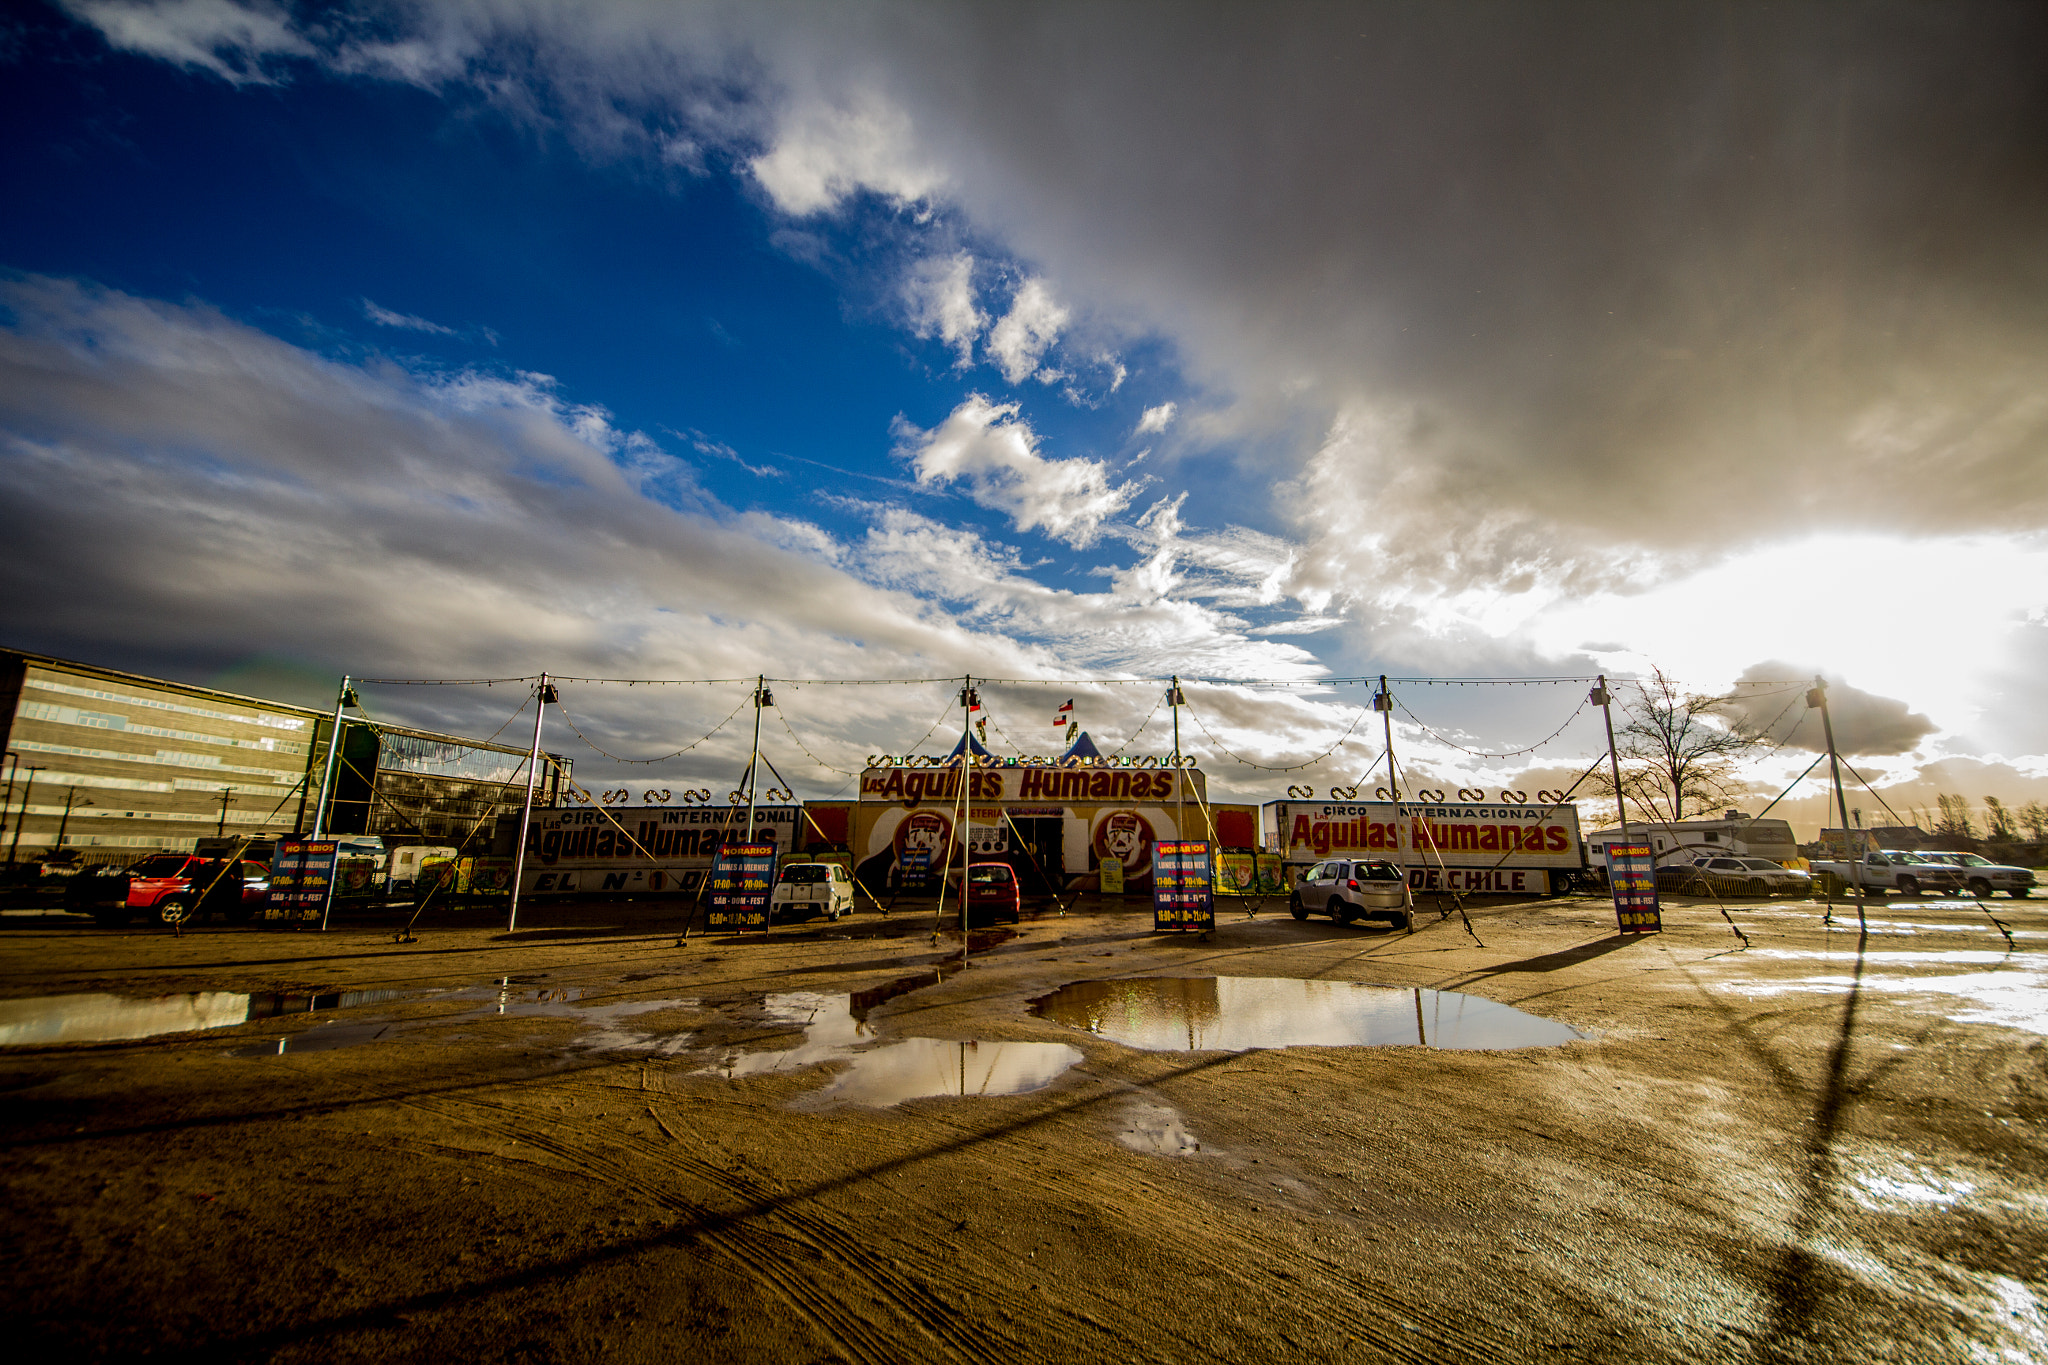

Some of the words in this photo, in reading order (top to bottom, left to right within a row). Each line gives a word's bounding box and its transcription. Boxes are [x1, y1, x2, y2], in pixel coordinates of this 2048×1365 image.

[862, 777, 885, 792] LAS
[881, 768, 1002, 808] Aguilas
[1019, 769, 1172, 798] Humanas
[560, 811, 623, 825] CIRCO
[662, 811, 794, 824] INTERNACONAL
[1323, 806, 1366, 816] CIRCO
[1400, 807, 1552, 819] NTERNACIONAL
[1290, 815, 1404, 855] Aguilas
[1411, 816, 1570, 852] Humanas
[285, 844, 335, 853] HORARIOS
[524, 822, 633, 865] Aguilas
[723, 847, 772, 855] HORARIOS
[1611, 847, 1650, 856] HORARIOS
[279, 861, 299, 869] LUNES
[305, 862, 331, 870] VIERNES
[718, 863, 738, 872] LUNES
[744, 863, 769, 872] VIERNES
[1158, 861, 1176, 870] LUNES
[533, 872, 576, 891] EL
[1409, 870, 1439, 890] DE
[1447, 871, 1526, 891] CHILE
[750, 896, 765, 905] FEST
